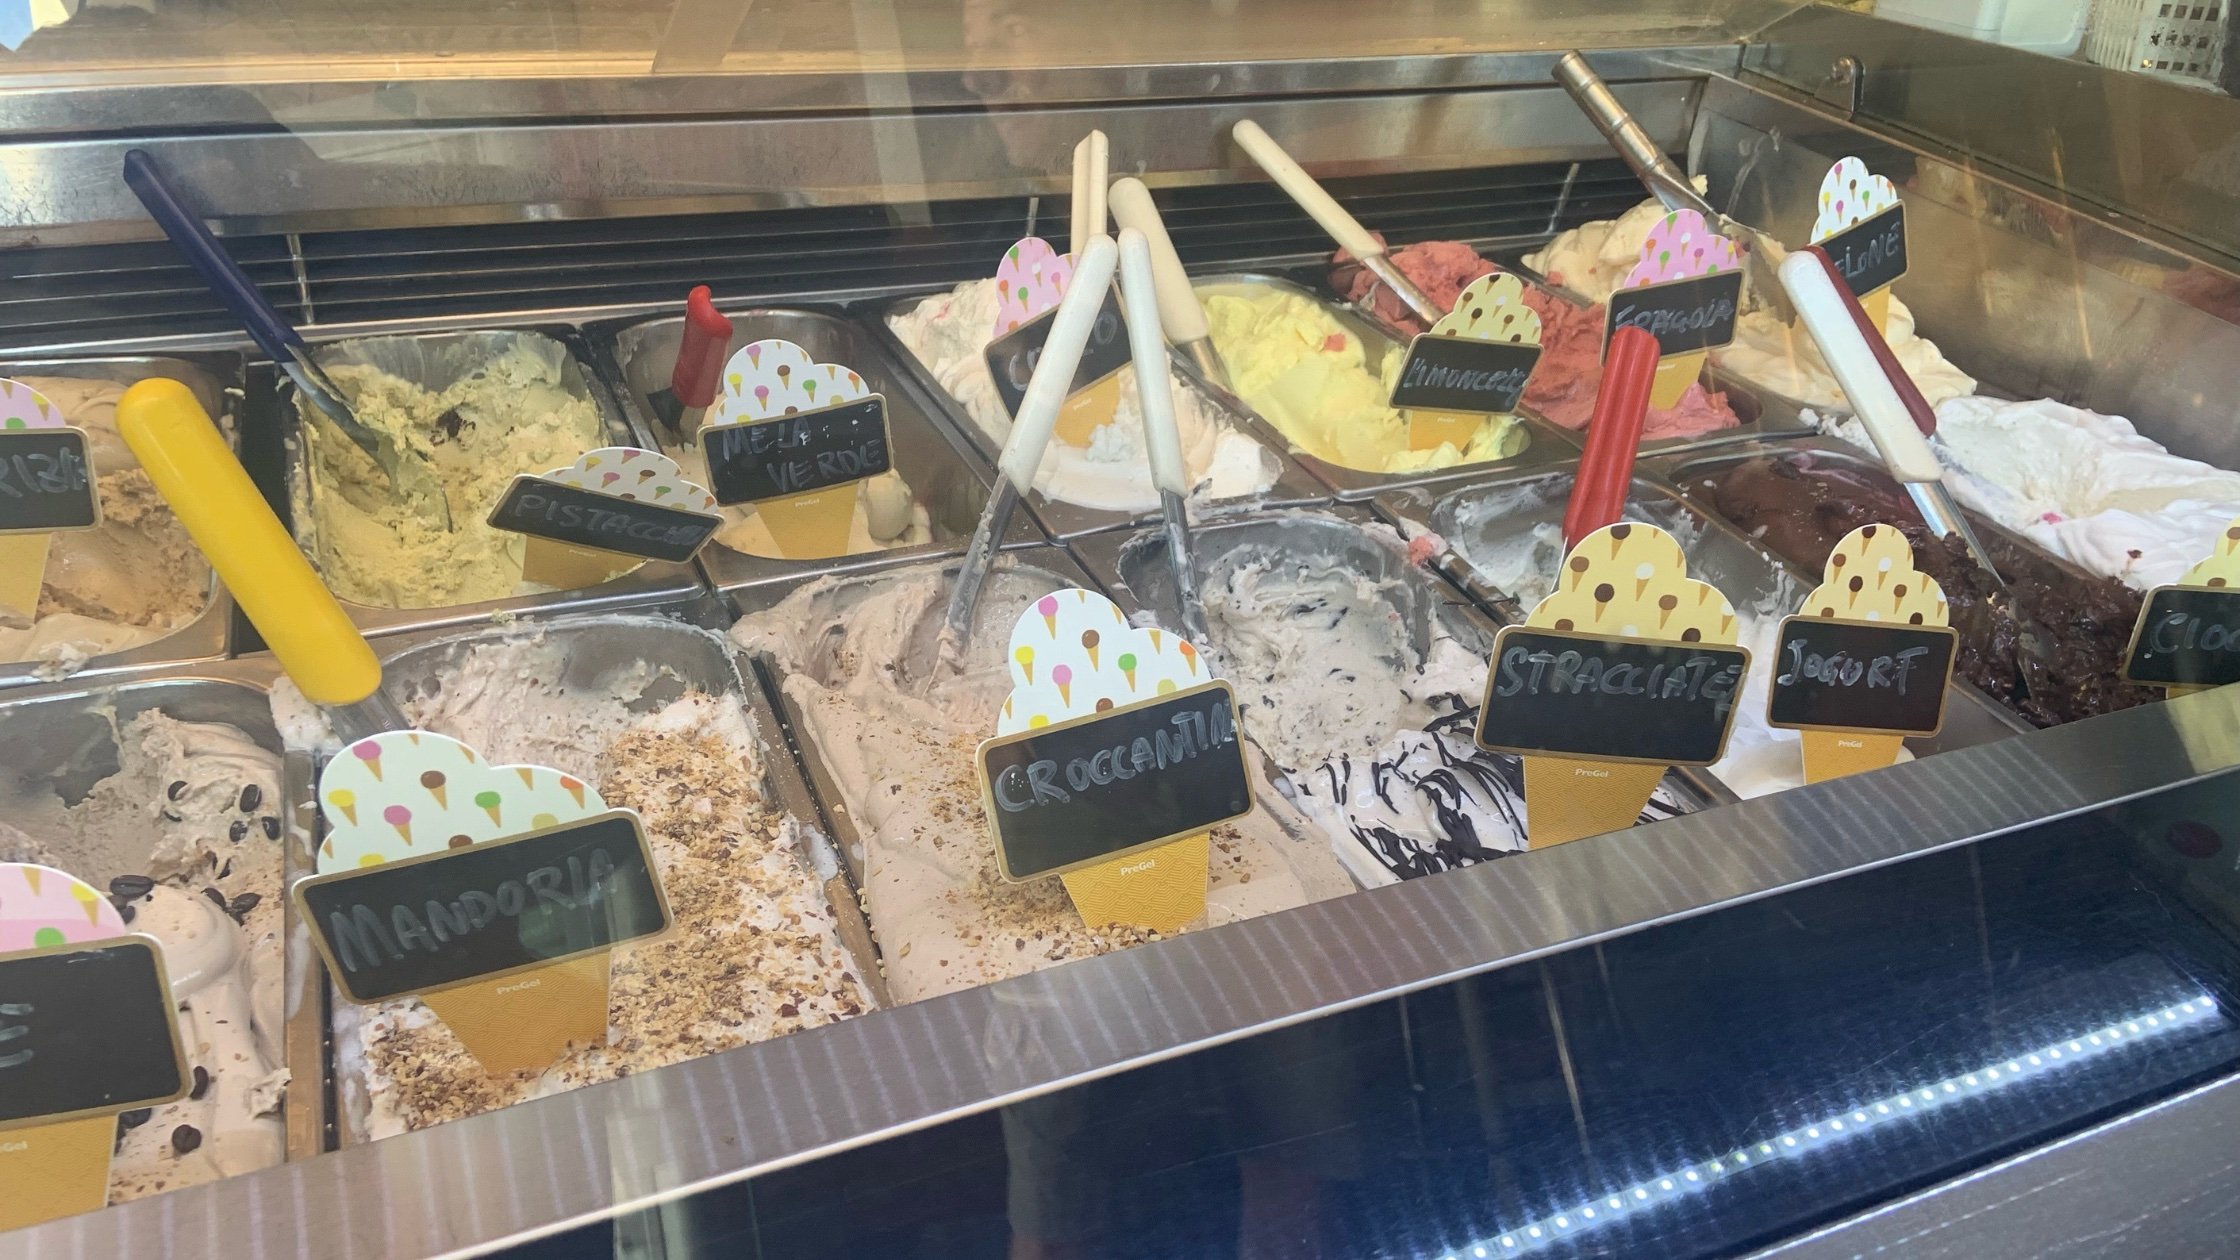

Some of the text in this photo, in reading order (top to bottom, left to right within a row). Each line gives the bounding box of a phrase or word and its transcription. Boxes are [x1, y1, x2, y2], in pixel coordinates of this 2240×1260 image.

[1833, 221, 1901, 278] ELONE
[766, 439, 882, 492] VERDE
[1574, 767, 1610, 779] PreGel
[1119, 859, 1157, 877] PreGel
[496, 978, 542, 995] PreGel
